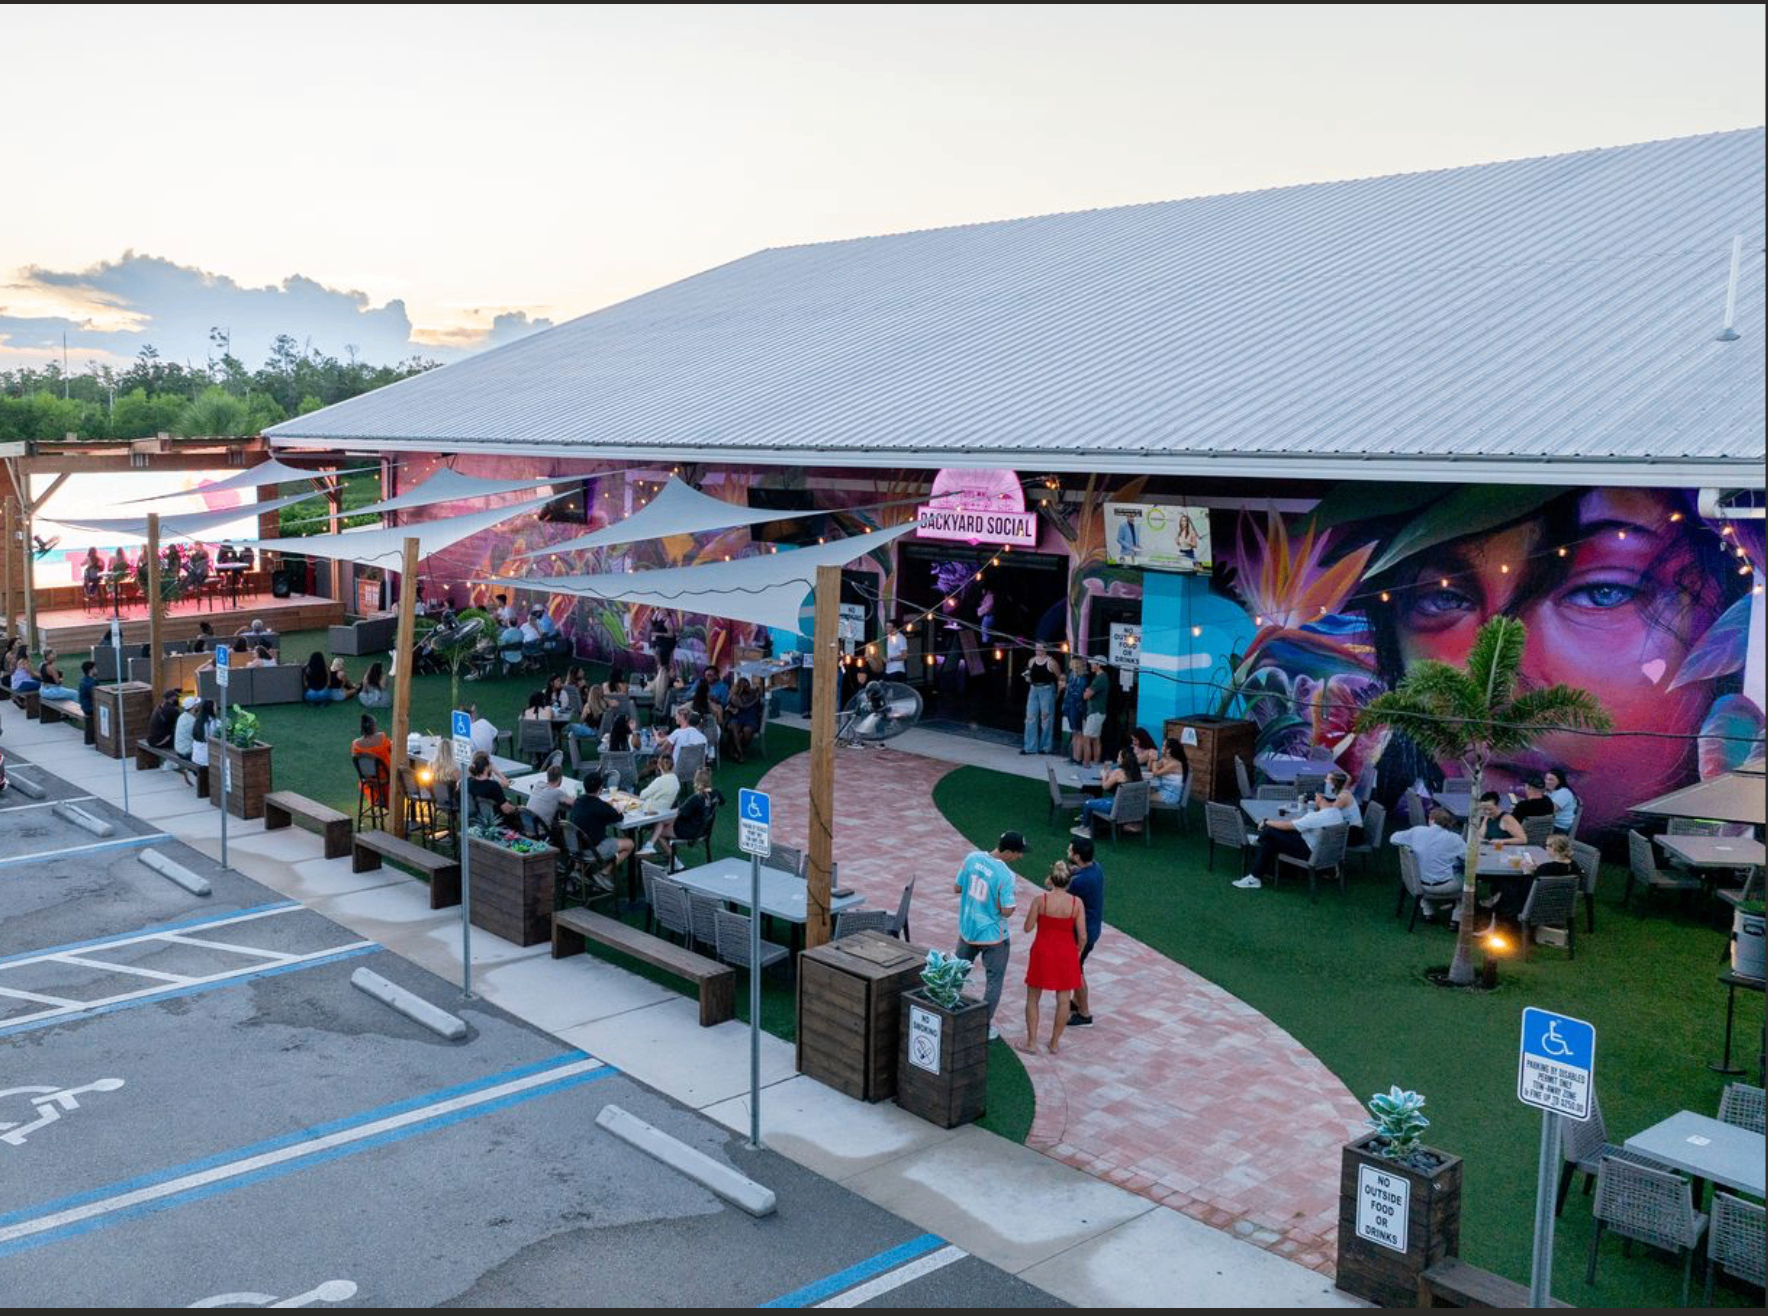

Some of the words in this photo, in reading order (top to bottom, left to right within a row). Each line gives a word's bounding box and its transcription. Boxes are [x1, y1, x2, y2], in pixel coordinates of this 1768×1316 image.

[920, 512, 983, 533] BACKYARD
[987, 517, 1032, 537] SOCIAL
[969, 874, 988, 902] 10
[922, 1014, 930, 1024] NO
[913, 1020, 938, 1038] SMOKING
[1526, 1060, 1549, 1074] PARKING
[1551, 1066, 1558, 1075] BY
[1559, 1068, 1585, 1084] DISABLED
[1538, 1072, 1558, 1085] PERMIT
[1559, 1079, 1573, 1089] ONLY
[1530, 1089, 1542, 1100] FINE
[1543, 1093, 1551, 1102] UP
[1533, 1080, 1561, 1096] TOW-AWAY
[1562, 1089, 1577, 1101] ZONE
[1377, 1175, 1391, 1188] NO
[1364, 1184, 1402, 1206] OUTSIDE
[1371, 1200, 1394, 1216] FOOD
[1375, 1215, 1388, 1228] OR
[1365, 1225, 1398, 1245] DRINKS
